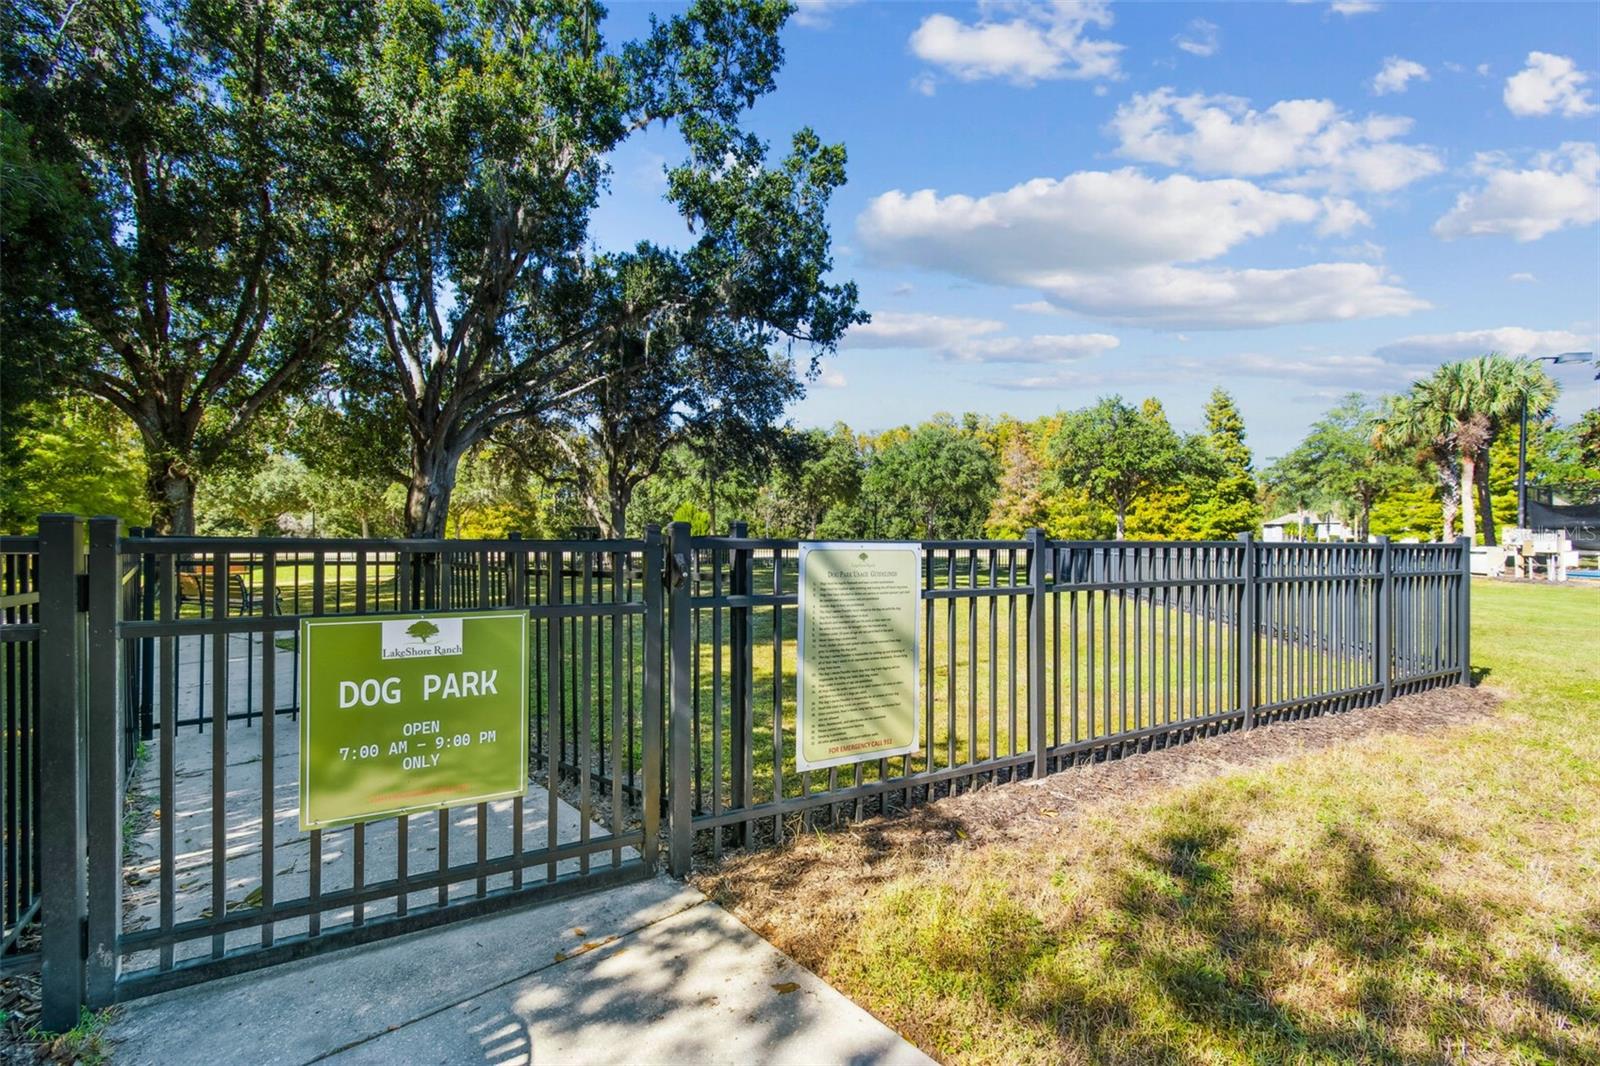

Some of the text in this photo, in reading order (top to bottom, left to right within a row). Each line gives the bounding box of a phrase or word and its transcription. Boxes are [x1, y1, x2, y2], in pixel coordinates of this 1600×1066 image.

[383, 645, 462, 657] LakeShore Ranch
[339, 669, 498, 708] DOG PARK
[403, 720, 440, 737] OPEN
[339, 744, 379, 761] 7:00
[388, 740, 408, 756] AM
[436, 733, 471, 749] 9:00
[479, 730, 497, 744] PM
[840, 743, 871, 753] EMERGENCY
[403, 753, 440, 770] ONLY
